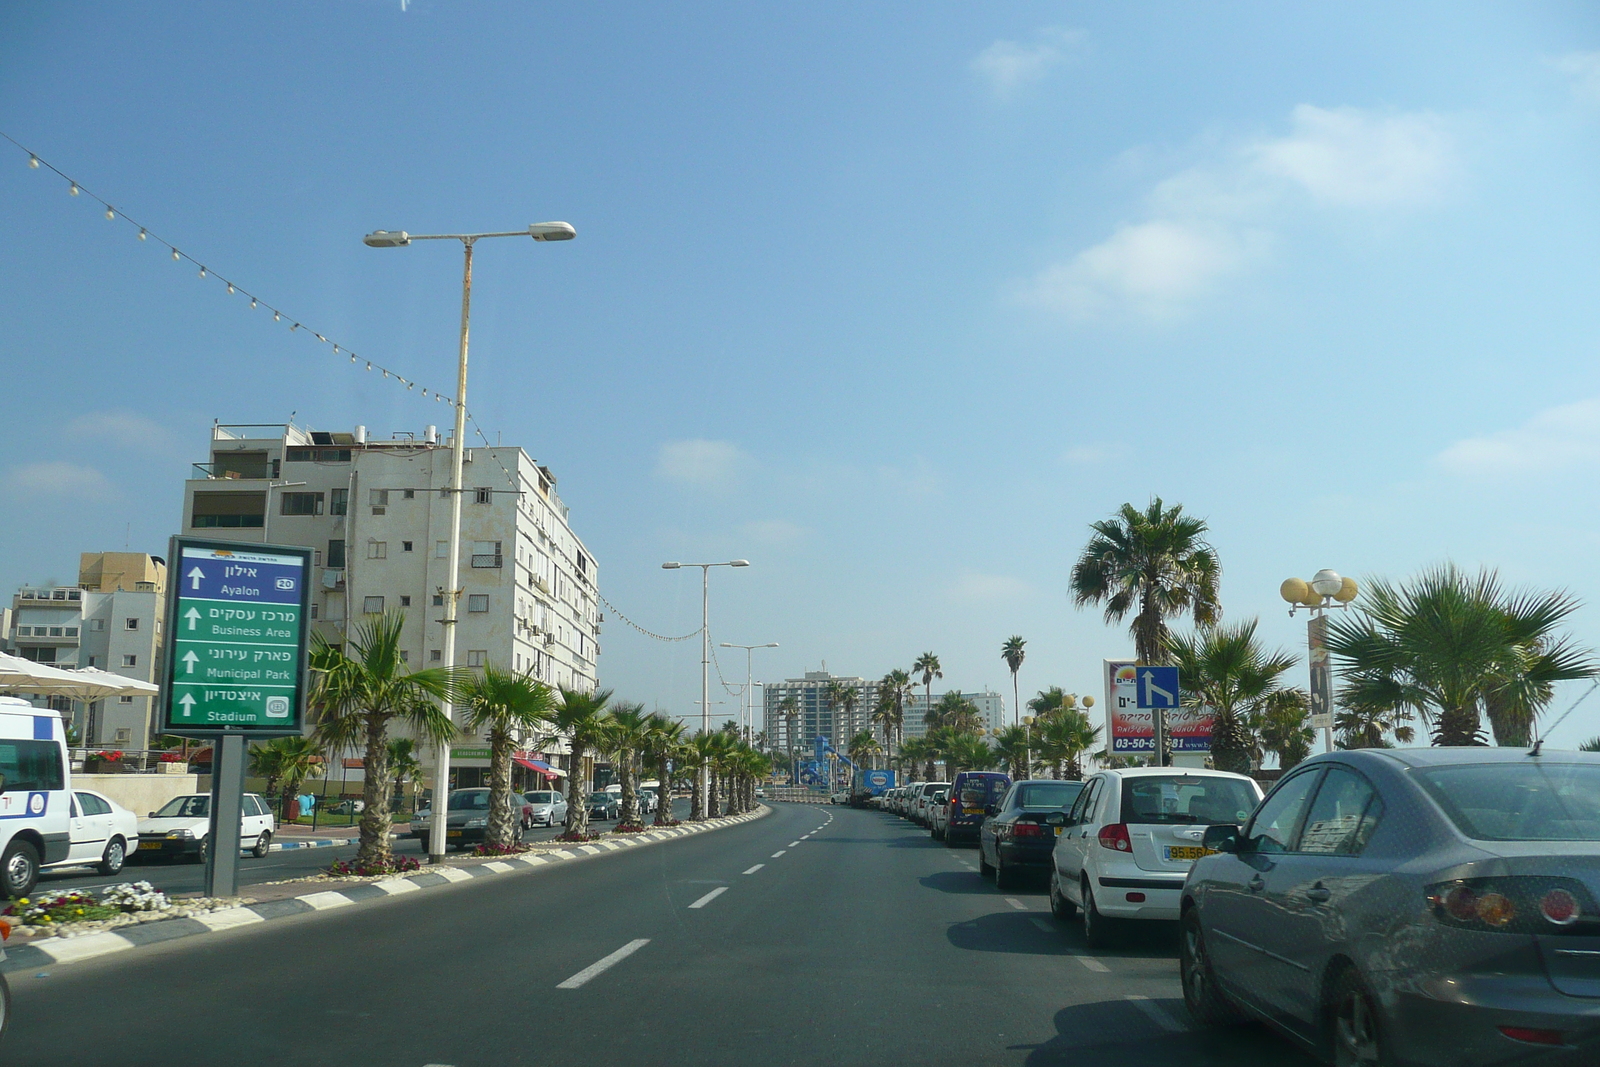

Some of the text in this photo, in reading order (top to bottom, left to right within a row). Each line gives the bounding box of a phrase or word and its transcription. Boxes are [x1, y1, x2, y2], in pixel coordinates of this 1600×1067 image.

[225, 564, 257, 578] אילון
[278, 580, 292, 588] 20
[220, 585, 260, 596] Ayalon
[209, 608, 296, 622] מרכז עסקים
[212, 625, 291, 638] Business Area
[208, 649, 291, 662] פארק עירוני
[207, 668, 290, 680] Municipal Park
[205, 690, 261, 702] איצטדיון
[207, 711, 257, 722] Stadium
